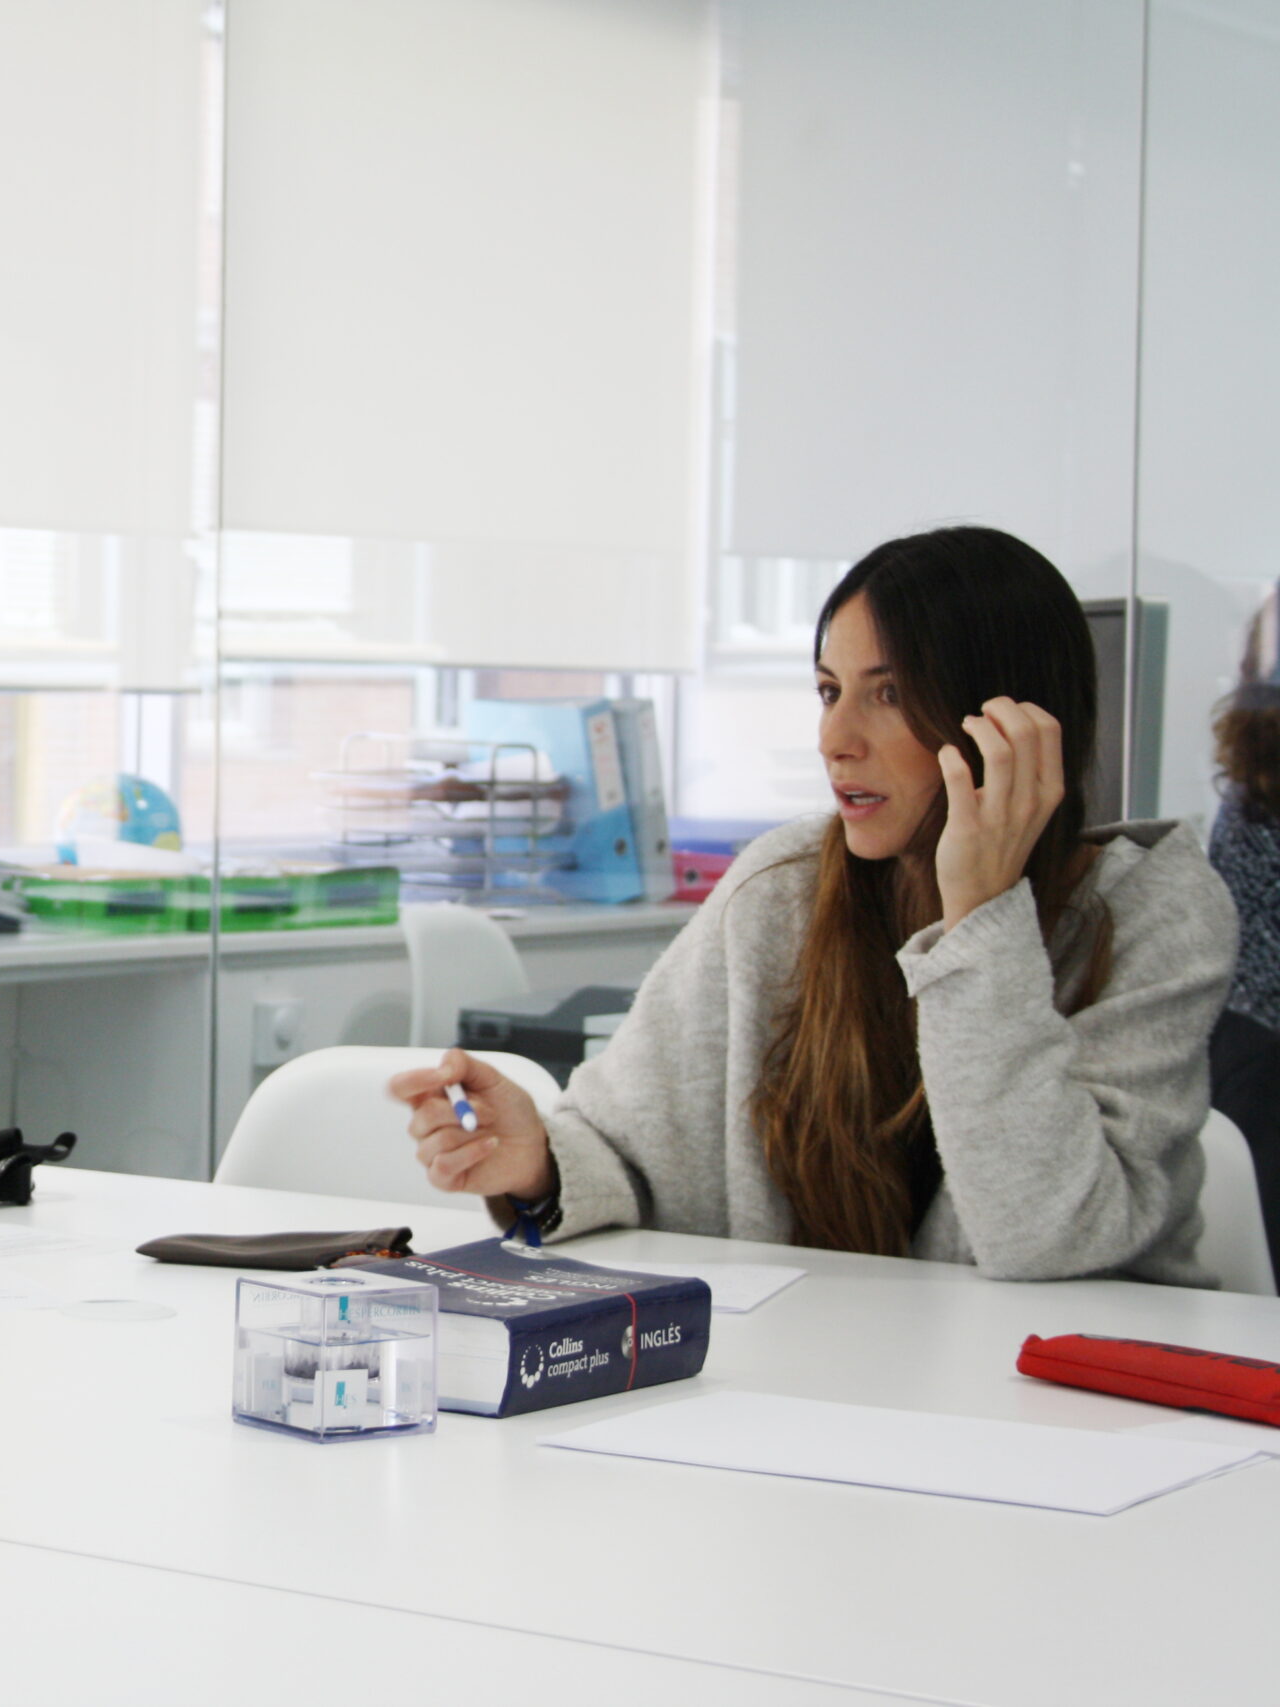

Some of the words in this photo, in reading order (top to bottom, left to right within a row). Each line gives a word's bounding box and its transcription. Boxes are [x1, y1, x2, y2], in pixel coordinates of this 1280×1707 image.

[548, 1337, 584, 1359] Collins
[639, 1322, 682, 1350] INGLÉS
[547, 1356, 589, 1379] compact
[588, 1348, 611, 1374] plus
